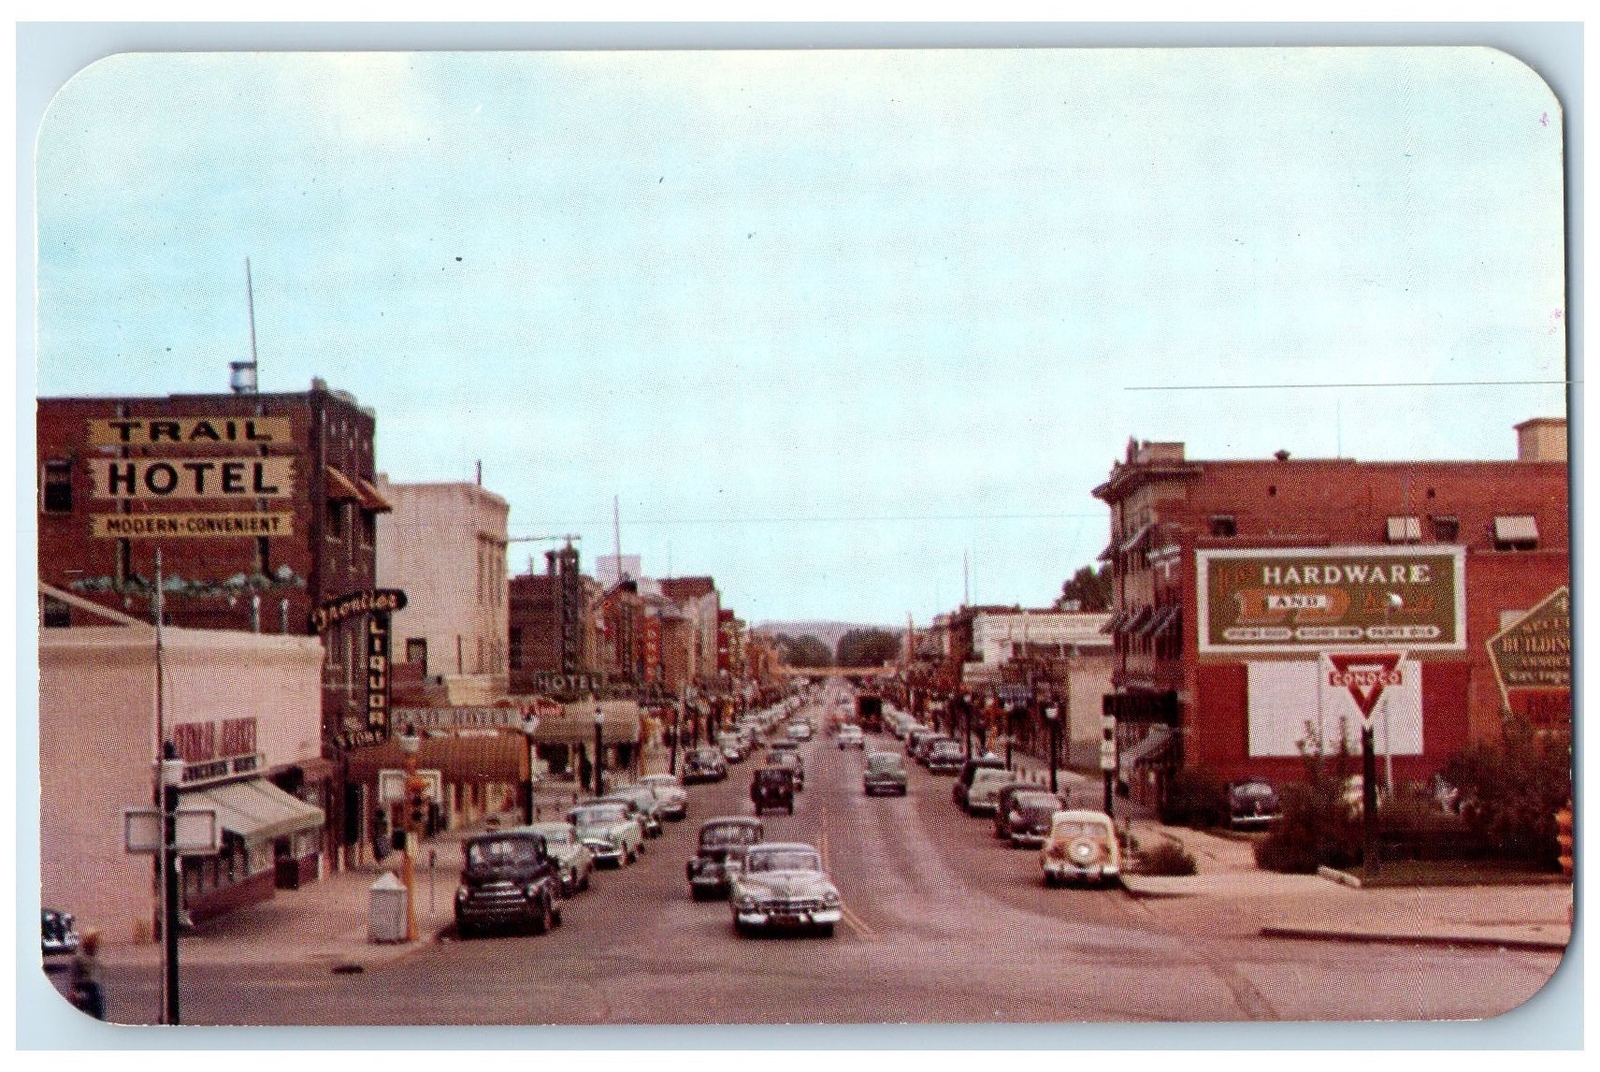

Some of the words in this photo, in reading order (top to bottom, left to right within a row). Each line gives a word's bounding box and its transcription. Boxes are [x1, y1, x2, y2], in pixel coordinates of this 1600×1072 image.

[108, 420, 274, 442] TRAIL
[107, 461, 280, 495] HOTEL
[1262, 564, 1432, 585] HARDWARE
[1275, 597, 1318, 607] AND
[369, 619, 387, 726] LIQUOR
[536, 675, 601, 690] HOTEL
[1331, 670, 1401, 686] CONOCO
